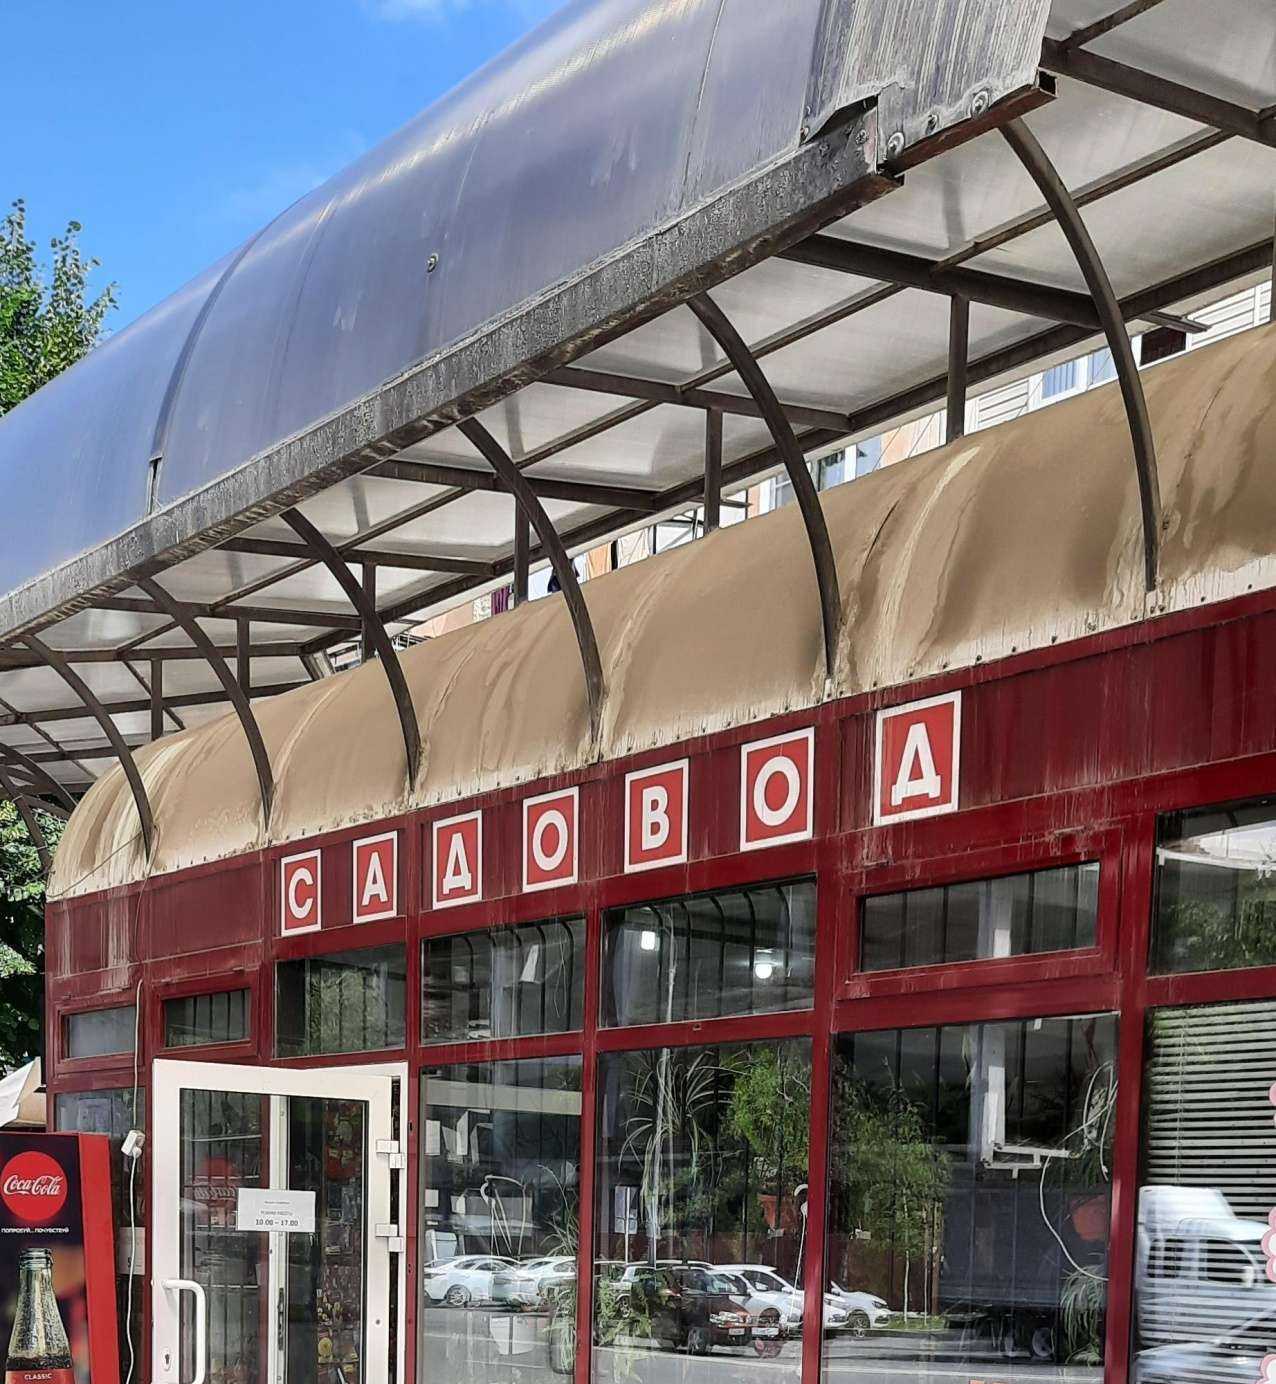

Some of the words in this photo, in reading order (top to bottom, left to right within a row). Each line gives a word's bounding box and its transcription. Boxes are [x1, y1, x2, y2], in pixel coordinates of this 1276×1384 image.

[287, 721, 941, 921] САДОВОД
[3, 1174, 64, 1196] Coca-Cola
[24, 1372, 53, 1380] CLASSIC
